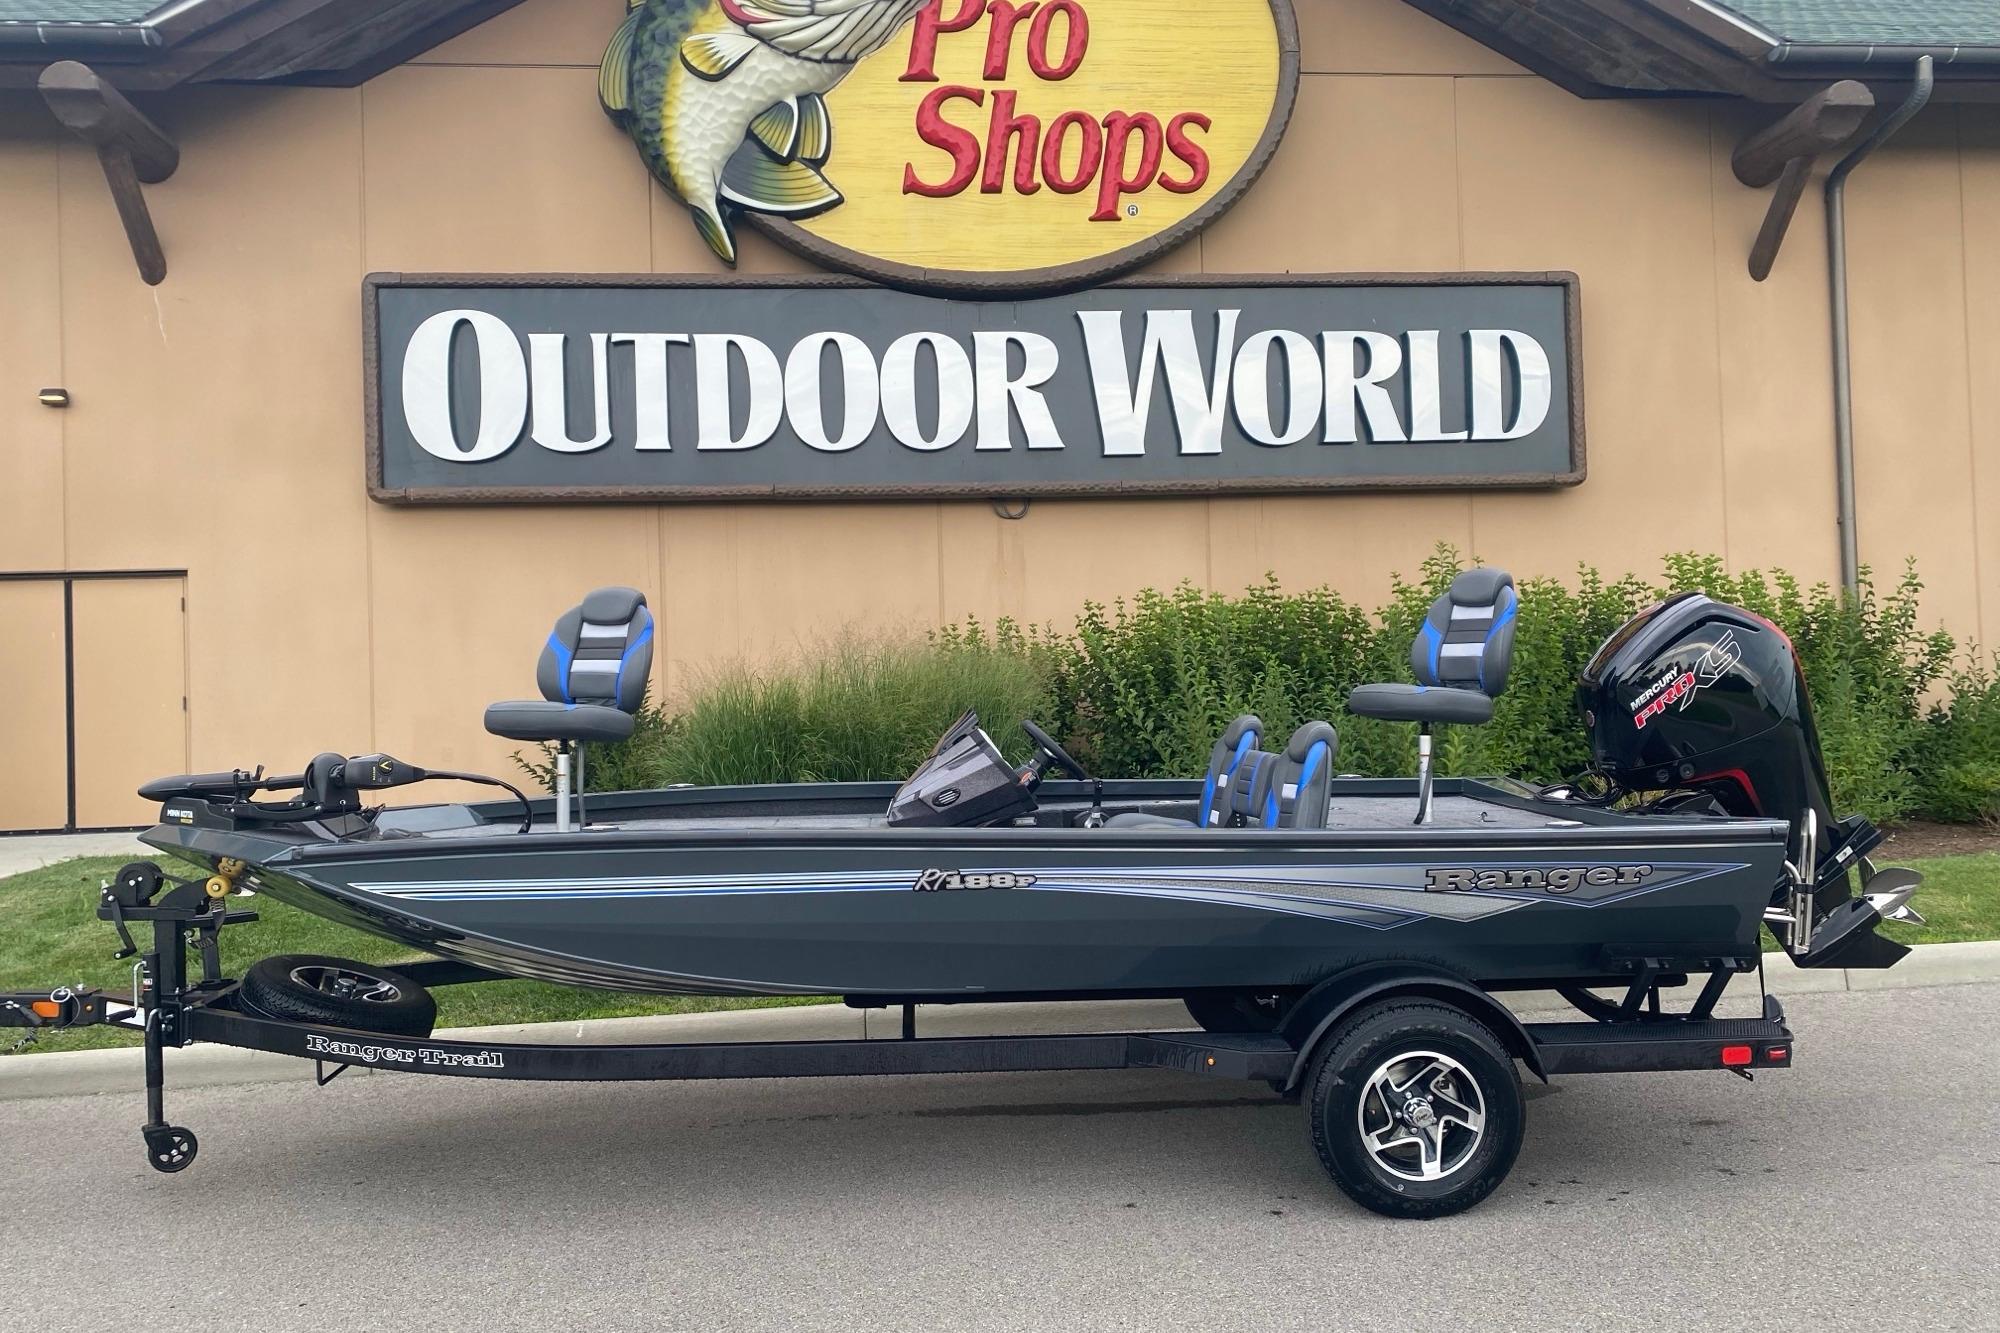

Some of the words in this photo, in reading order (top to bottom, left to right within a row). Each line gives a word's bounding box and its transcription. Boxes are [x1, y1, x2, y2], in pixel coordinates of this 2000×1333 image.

[898, 0, 1090, 82] Pro
[902, 85, 1212, 222] Shops
[402, 308, 1066, 462] OUTDOOR
[1075, 308, 1552, 456] WORLD
[1630, 666, 1679, 711] MERCURY
[1425, 864, 1654, 894] Ranger
[306, 1034, 416, 1063] Ranger
[418, 1048, 505, 1068] Trail
